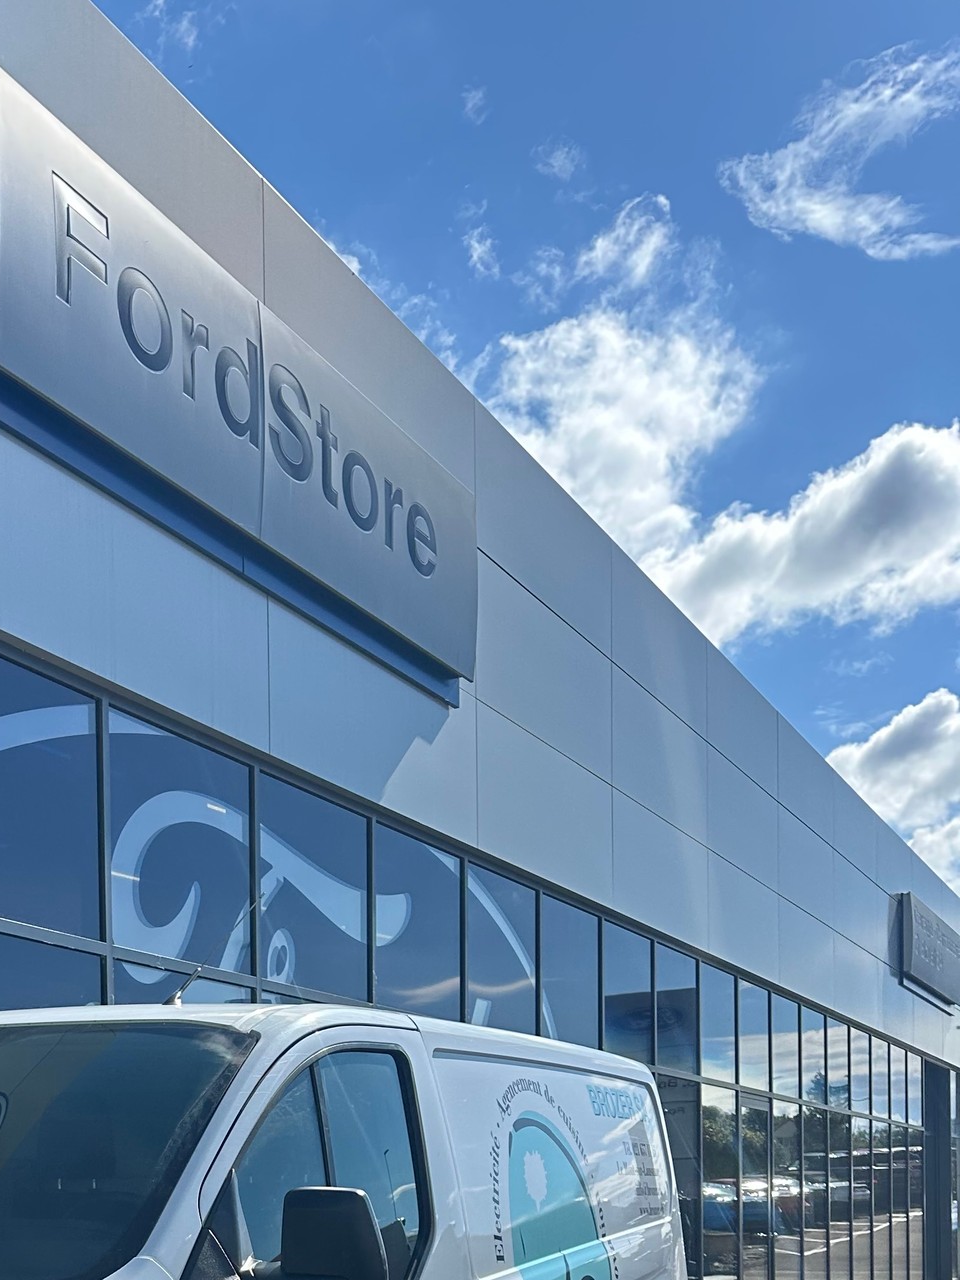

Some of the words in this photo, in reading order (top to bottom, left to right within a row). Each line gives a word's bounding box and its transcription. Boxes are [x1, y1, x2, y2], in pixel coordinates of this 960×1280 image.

[51, 170, 439, 579] FordStore
[496, 1078, 543, 1121] Agencement
[544, 1083, 555, 1108] de
[586, 1084, 638, 1120] BROZER
[557, 1106, 589, 1166] cuisine
[490, 1131, 506, 1263] Electricité
